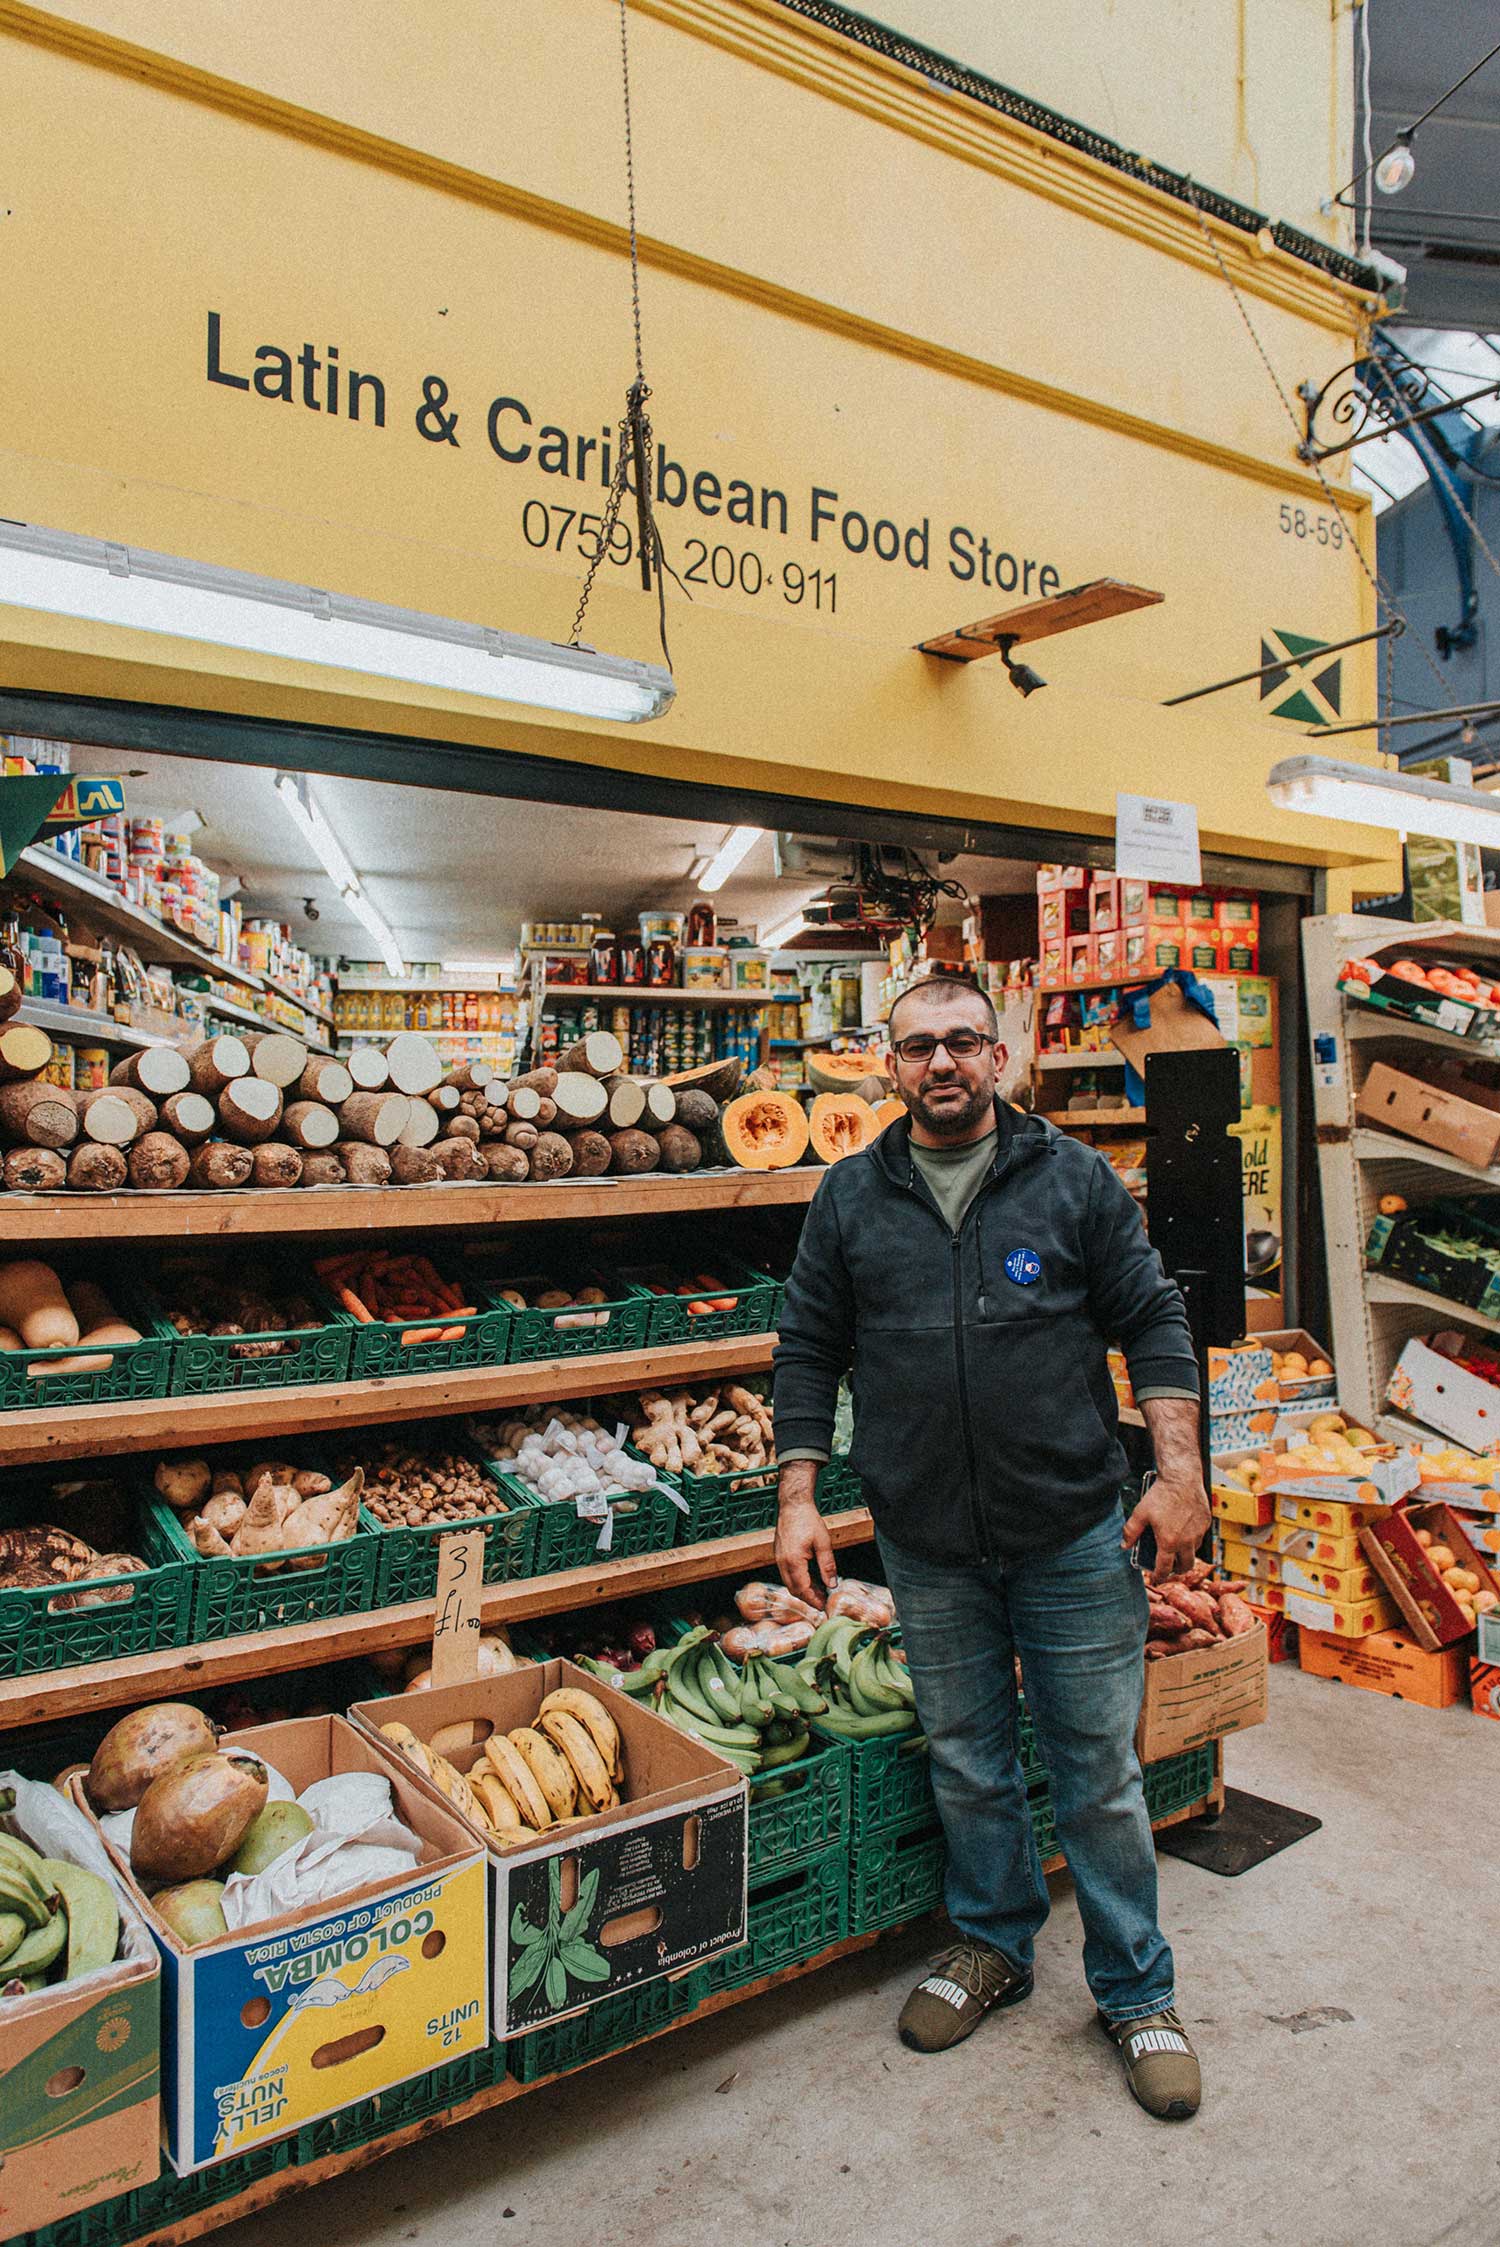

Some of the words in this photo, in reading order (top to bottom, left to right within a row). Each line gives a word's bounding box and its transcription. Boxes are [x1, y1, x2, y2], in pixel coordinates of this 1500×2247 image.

[208, 311, 386, 428] Latin
[416, 375, 461, 448] &
[810, 487, 930, 571] Food
[948, 527, 1061, 598] Store
[1280, 503, 1343, 550] 58-59
[684, 538, 762, 595] 200
[783, 561, 837, 613] 911
[1244, 1138, 1267, 1168] old
[1240, 1169, 1270, 1197] ERE
[449, 1545, 468, 1581] 3
[435, 1589, 481, 1636] £1.00
[373, 1884, 442, 1922] PRODUCT
[290, 1919, 346, 1951] COSTA
[349, 1909, 371, 1932] OF
[245, 1935, 287, 1965] RICA
[262, 1909, 435, 1993] COLOMBA
[698, 1942, 708, 1953] of
[709, 1928, 740, 1947] Product
[658, 1945, 697, 1966] Colombia
[918, 1977, 969, 2010] PUMA
[427, 1999, 479, 2036] UNITS
[442, 2026, 462, 2048] 12
[1130, 2030, 1189, 2058] PUMA
[219, 2078, 284, 2117] NUTS
[214, 2098, 288, 2142] JELLY
